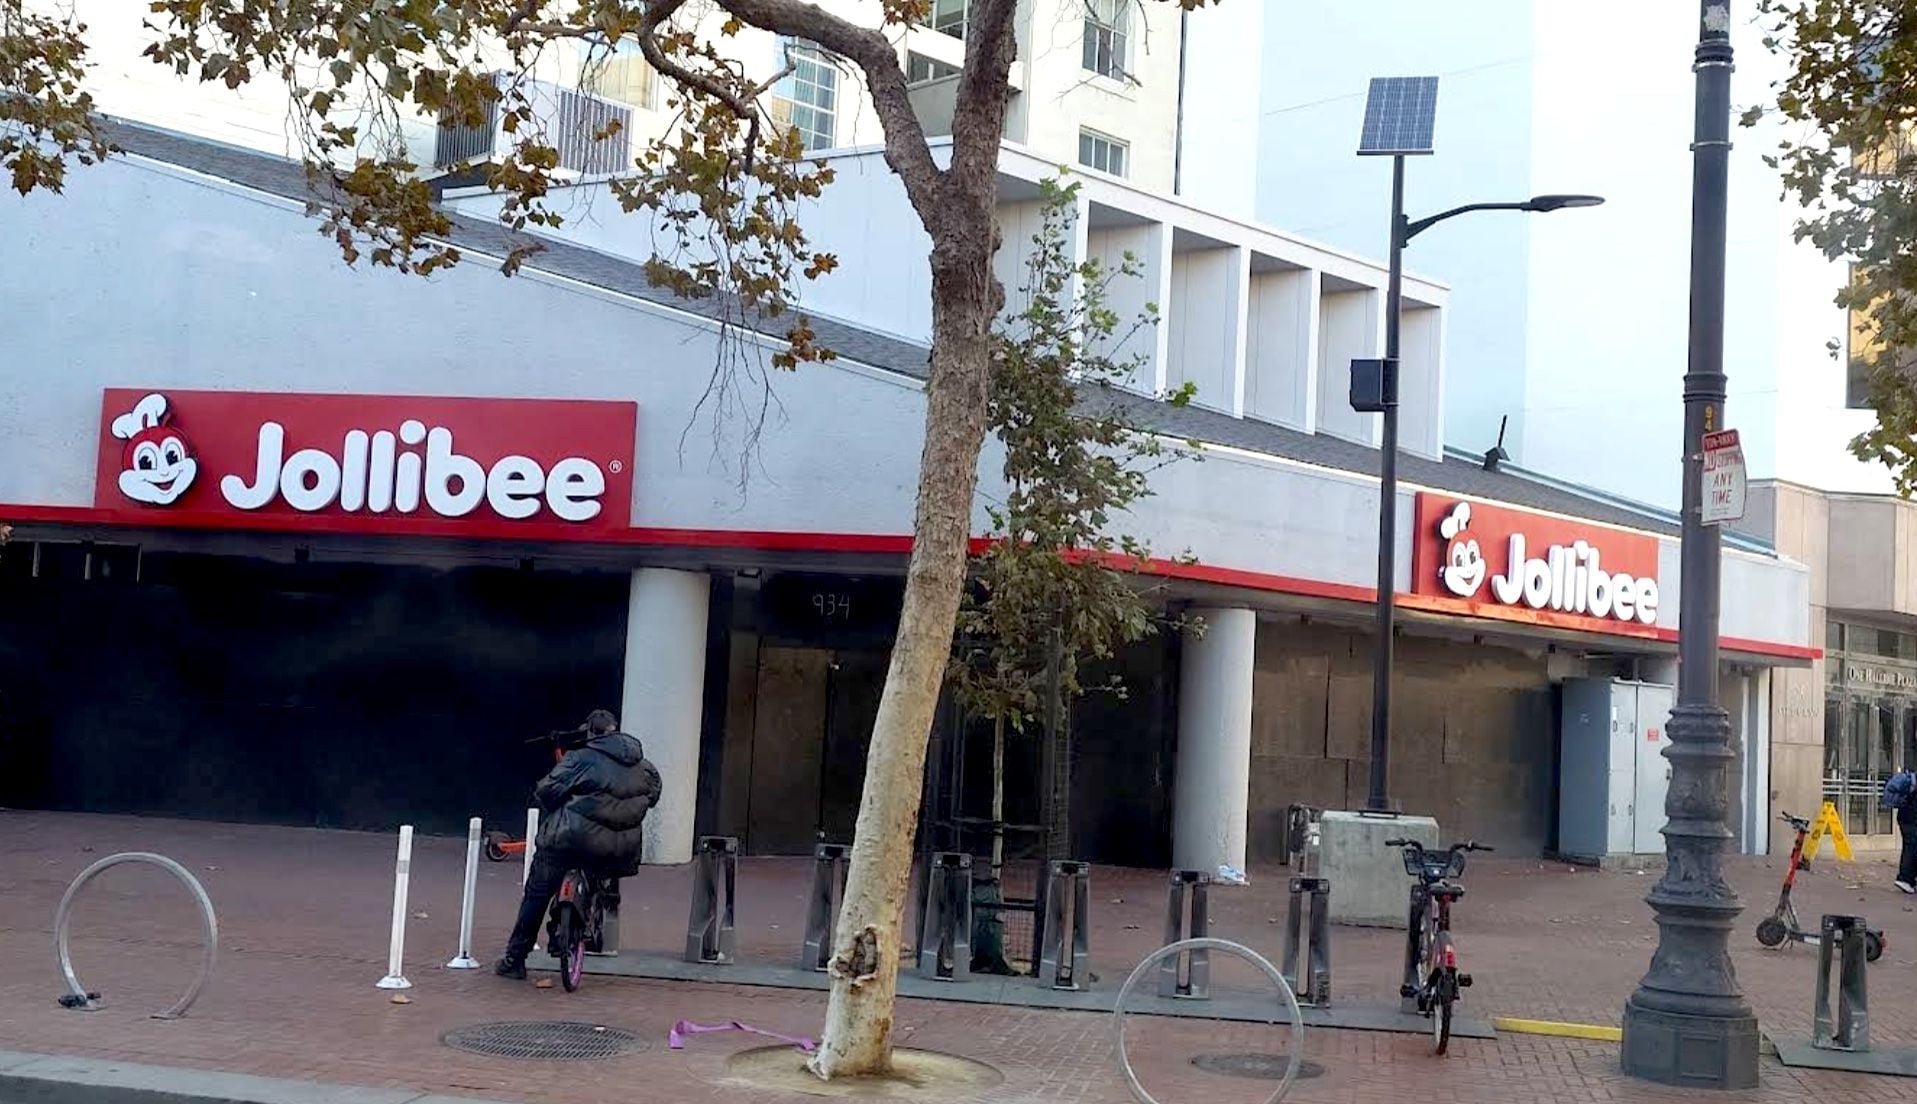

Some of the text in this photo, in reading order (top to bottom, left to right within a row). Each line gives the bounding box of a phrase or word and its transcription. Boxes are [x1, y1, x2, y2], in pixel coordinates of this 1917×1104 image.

[220, 420, 605, 521] Jollibee
[1713, 473, 1733, 487] ANY
[1712, 489, 1732, 505] TIME
[1491, 533, 1658, 624] Jollibee
[812, 594, 850, 621] 934
